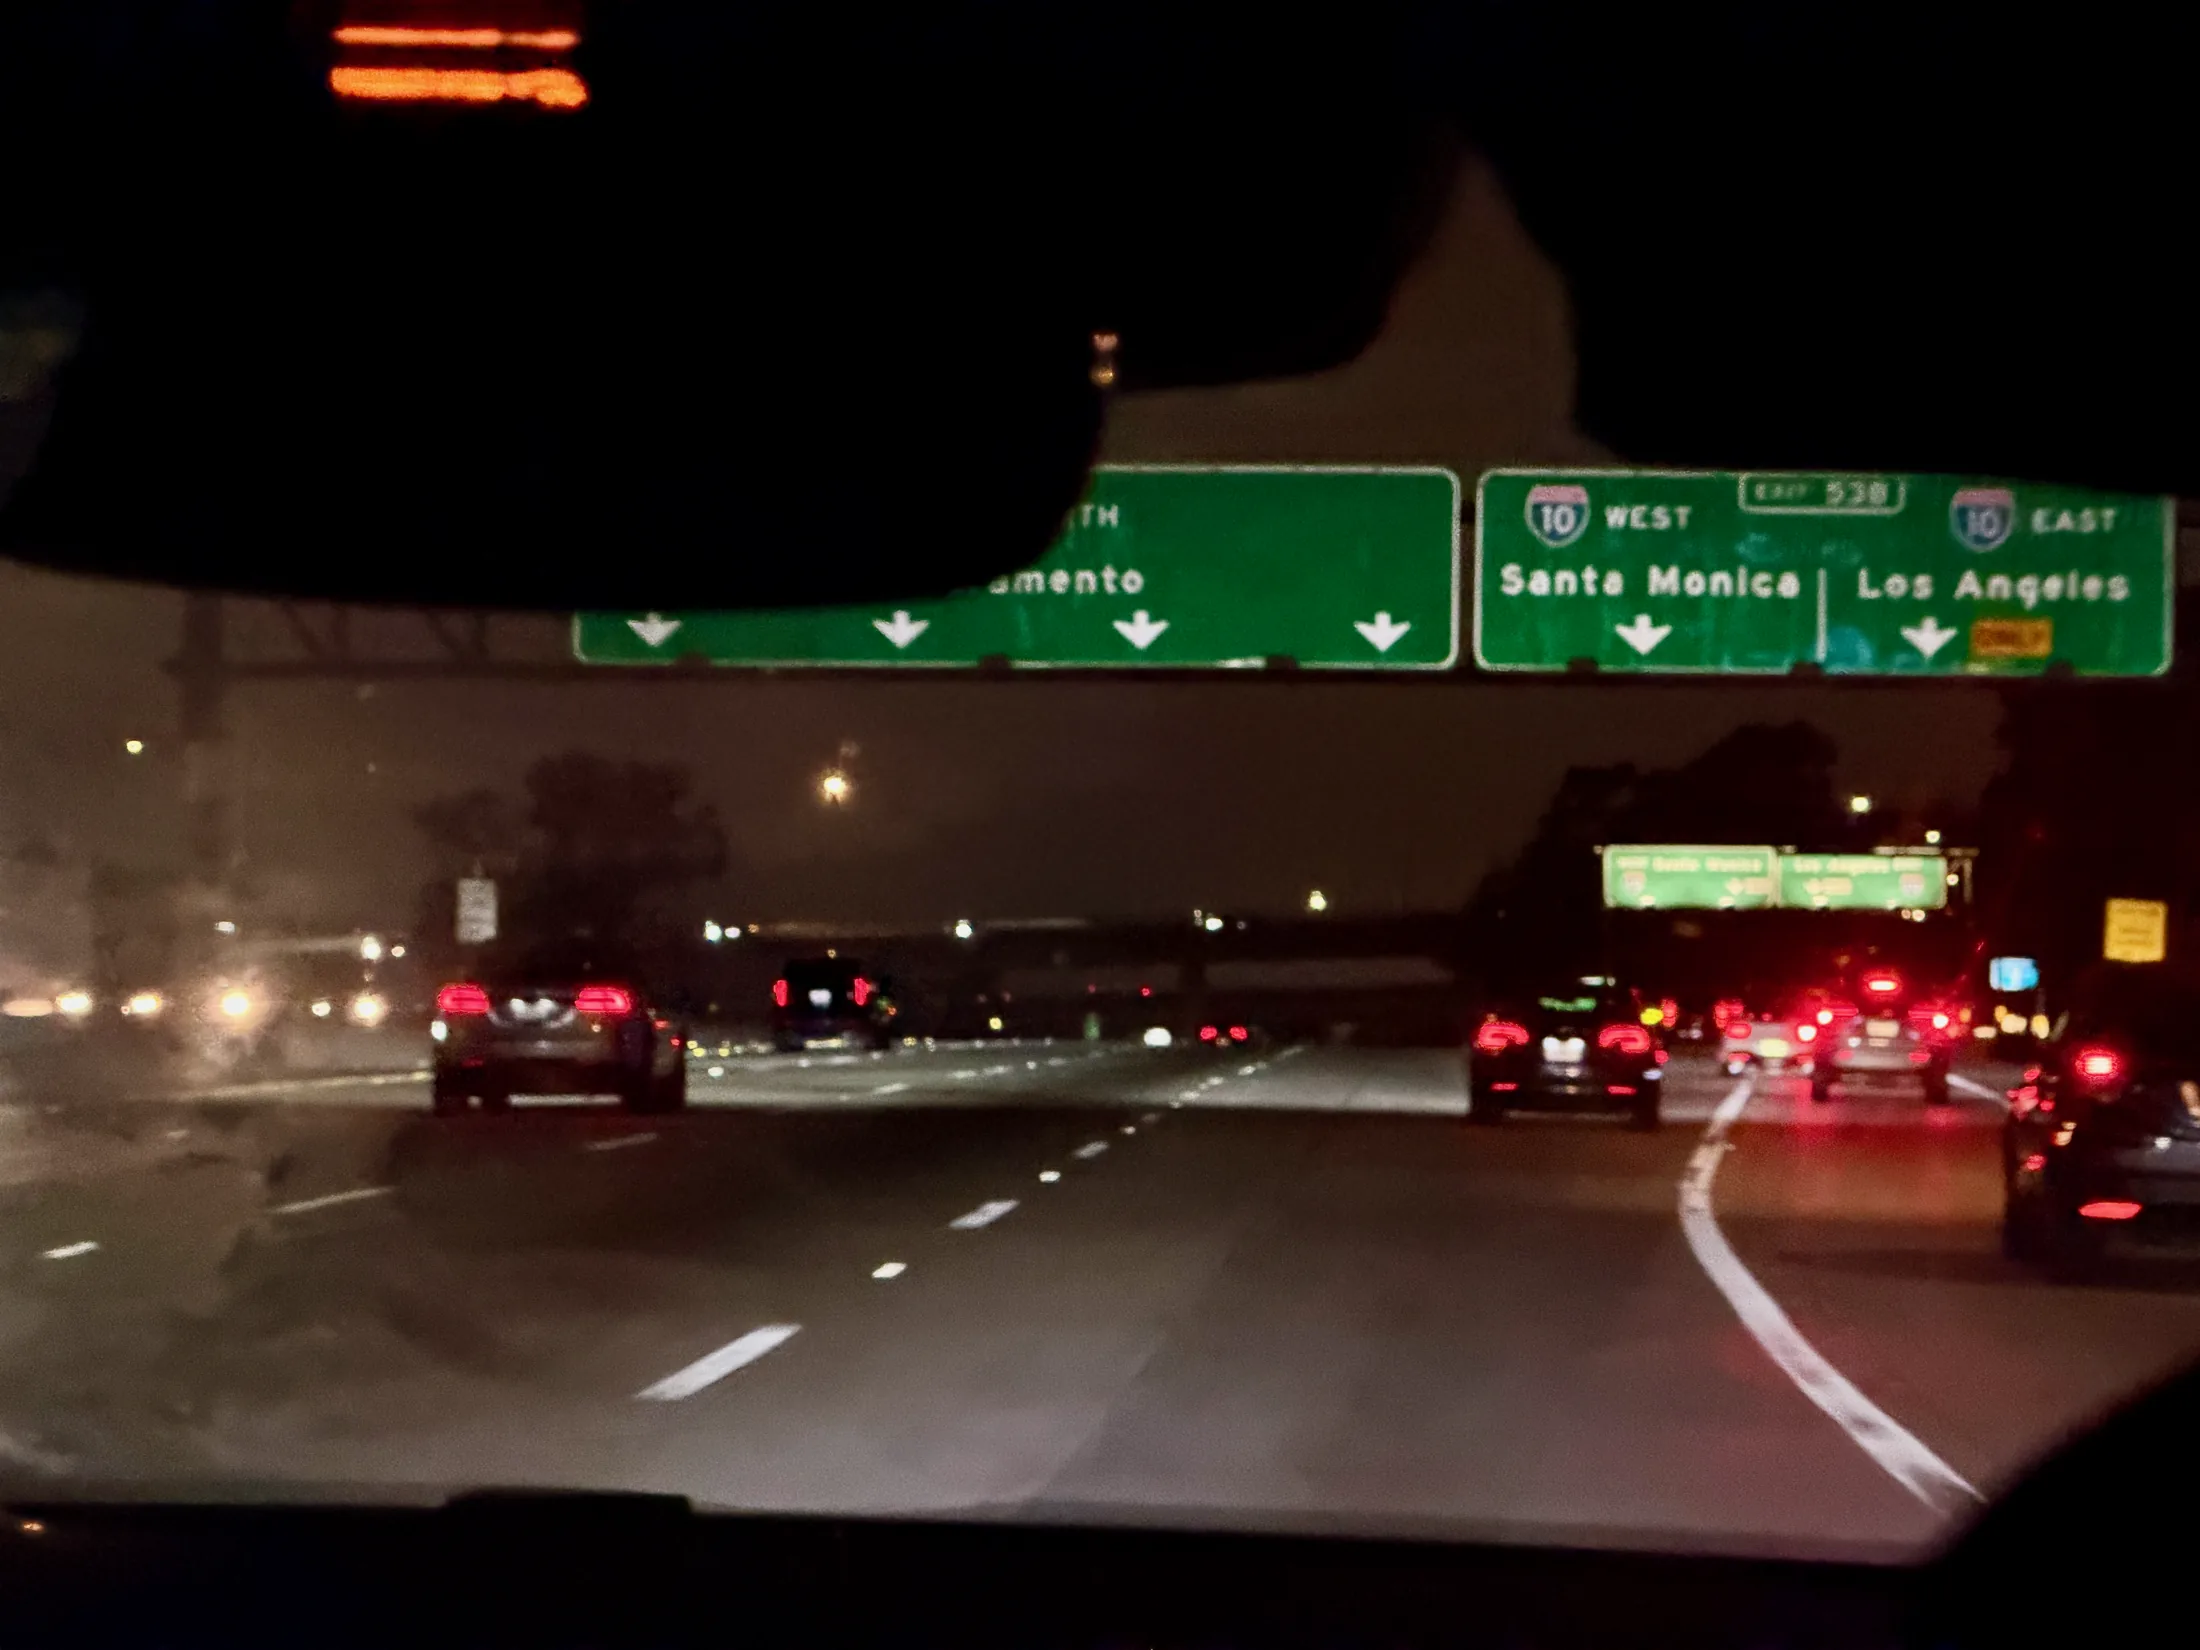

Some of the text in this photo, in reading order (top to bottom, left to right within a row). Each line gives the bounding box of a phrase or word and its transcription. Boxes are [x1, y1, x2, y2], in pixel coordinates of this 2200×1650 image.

[1066, 503, 1119, 529] TH
[1541, 503, 1692, 535] 10 WEST
[1966, 507, 2117, 538] 10 EAST
[1500, 562, 1801, 599] Santa Monica
[1857, 567, 2131, 611] Los Angeles
